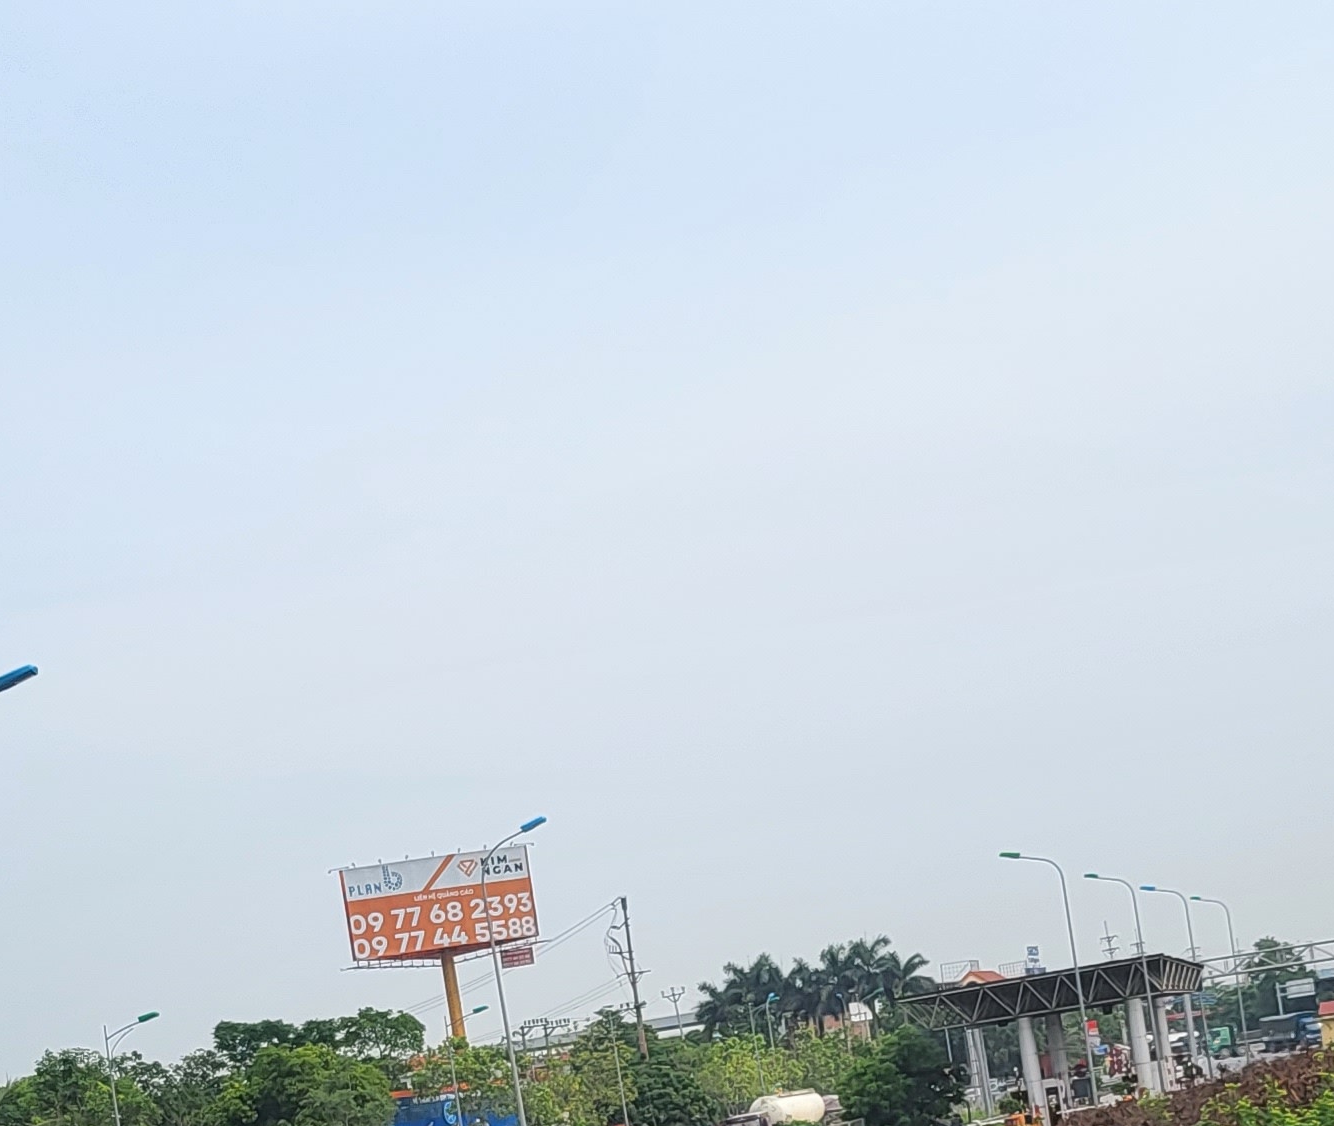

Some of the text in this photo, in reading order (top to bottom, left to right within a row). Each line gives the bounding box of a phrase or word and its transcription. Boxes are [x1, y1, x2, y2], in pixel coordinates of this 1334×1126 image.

[348, 882, 382, 897] PLAN
[350, 892, 532, 935] 09 77 68 2393
[353, 916, 536, 959] 09 77 44 5588
